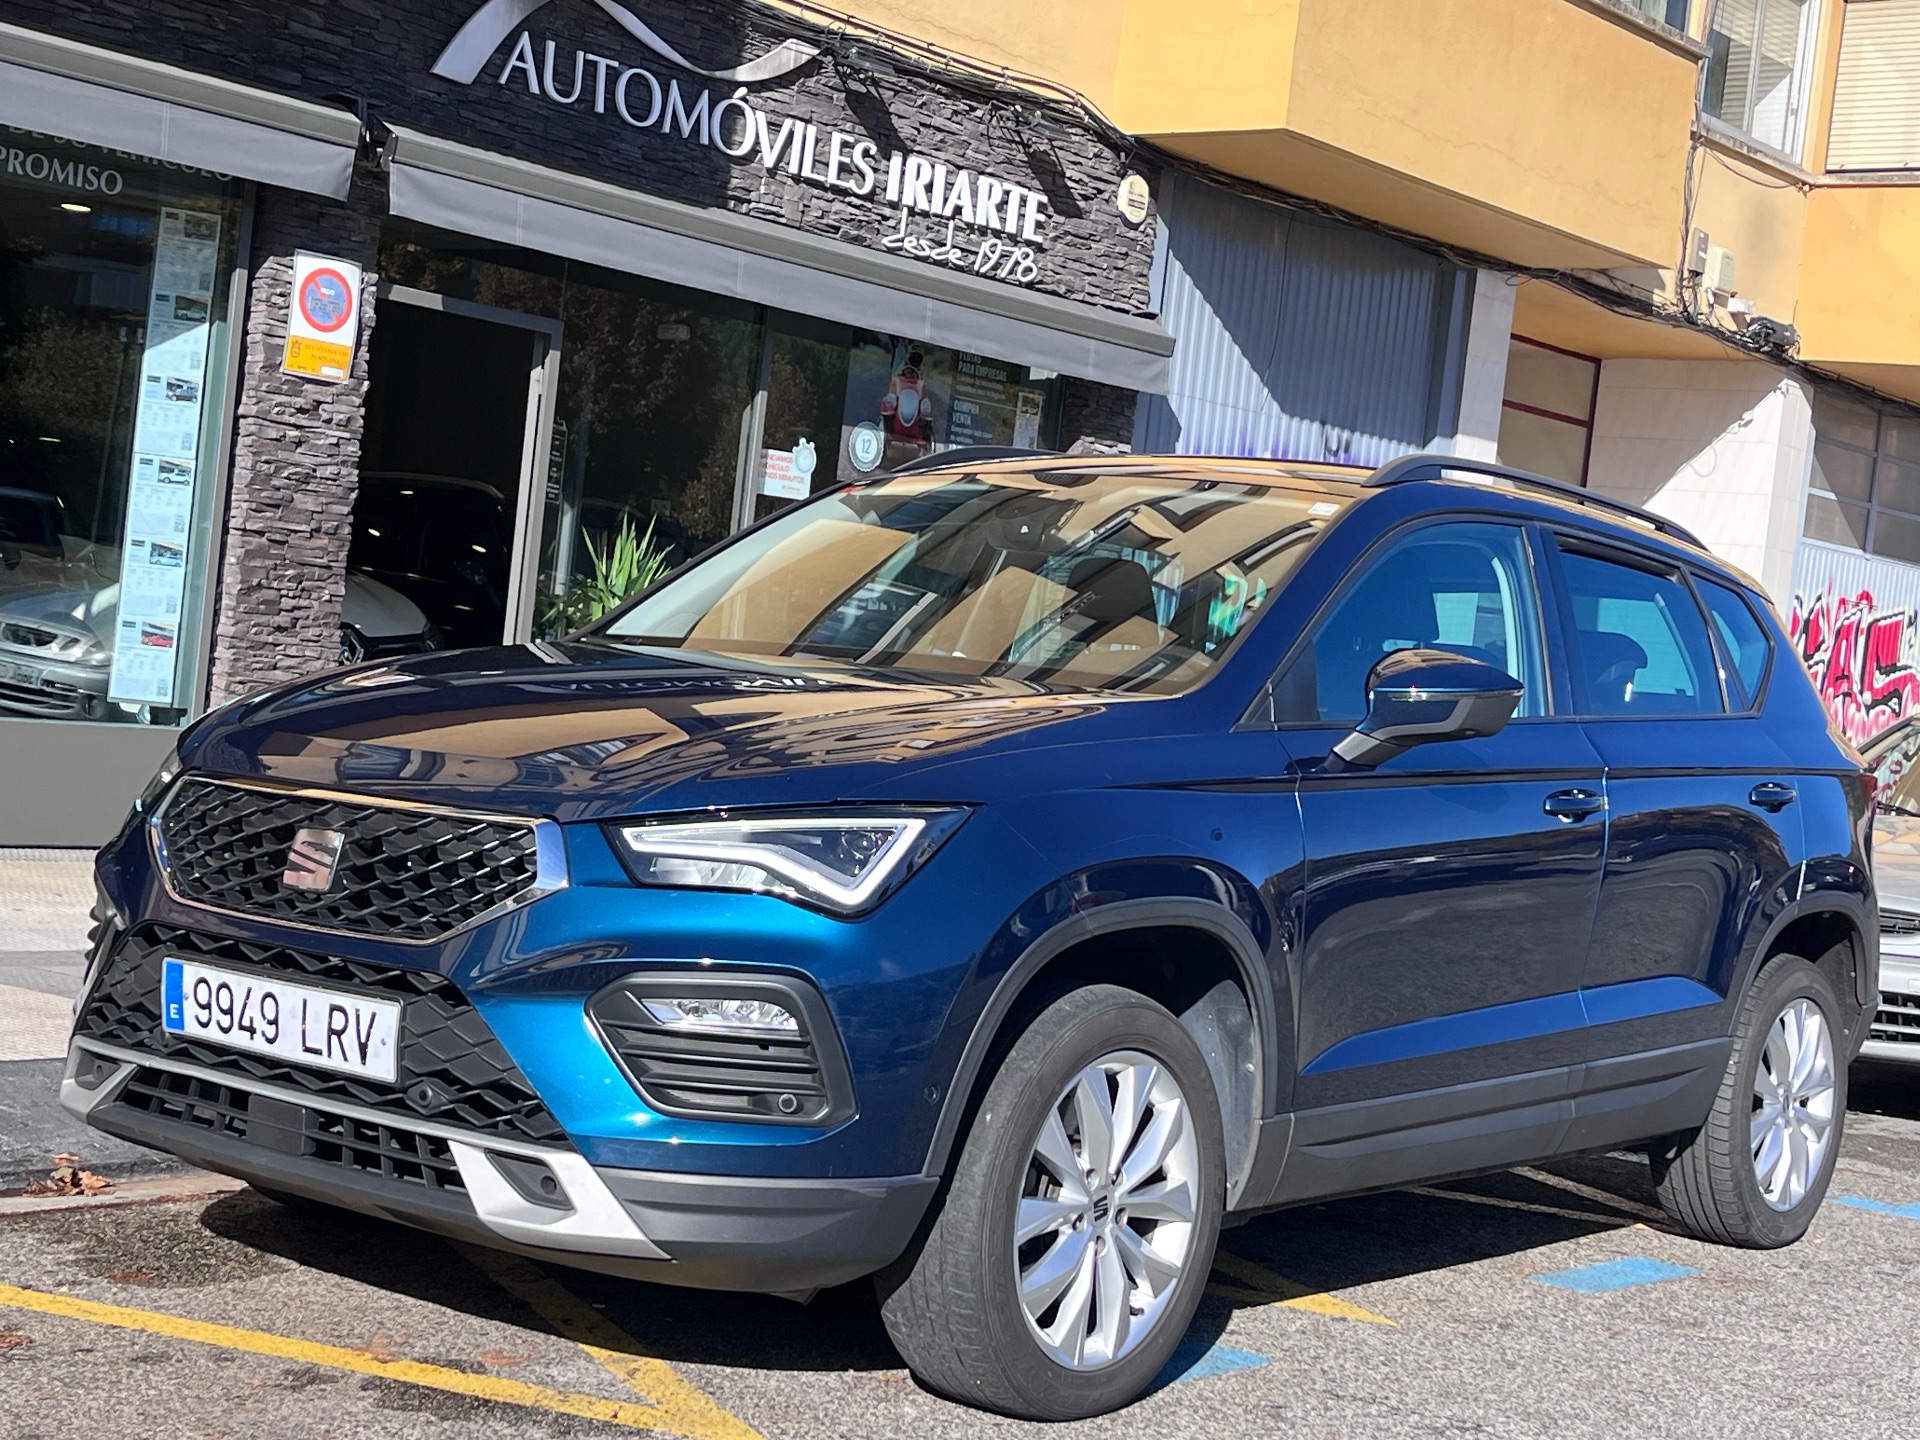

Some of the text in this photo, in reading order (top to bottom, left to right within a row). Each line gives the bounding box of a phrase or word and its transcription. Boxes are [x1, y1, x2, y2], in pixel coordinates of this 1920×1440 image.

[497, 30, 1048, 244] AUTOMÓVILES IRIARTE
[881, 206, 1038, 283] desde 1978
[953, 399, 980, 415] COMPRA
[952, 411, 972, 426] VENTA
[862, 437, 872, 454] 12
[169, 1003, 180, 1019] E
[193, 976, 377, 1066] 9949 LRV
